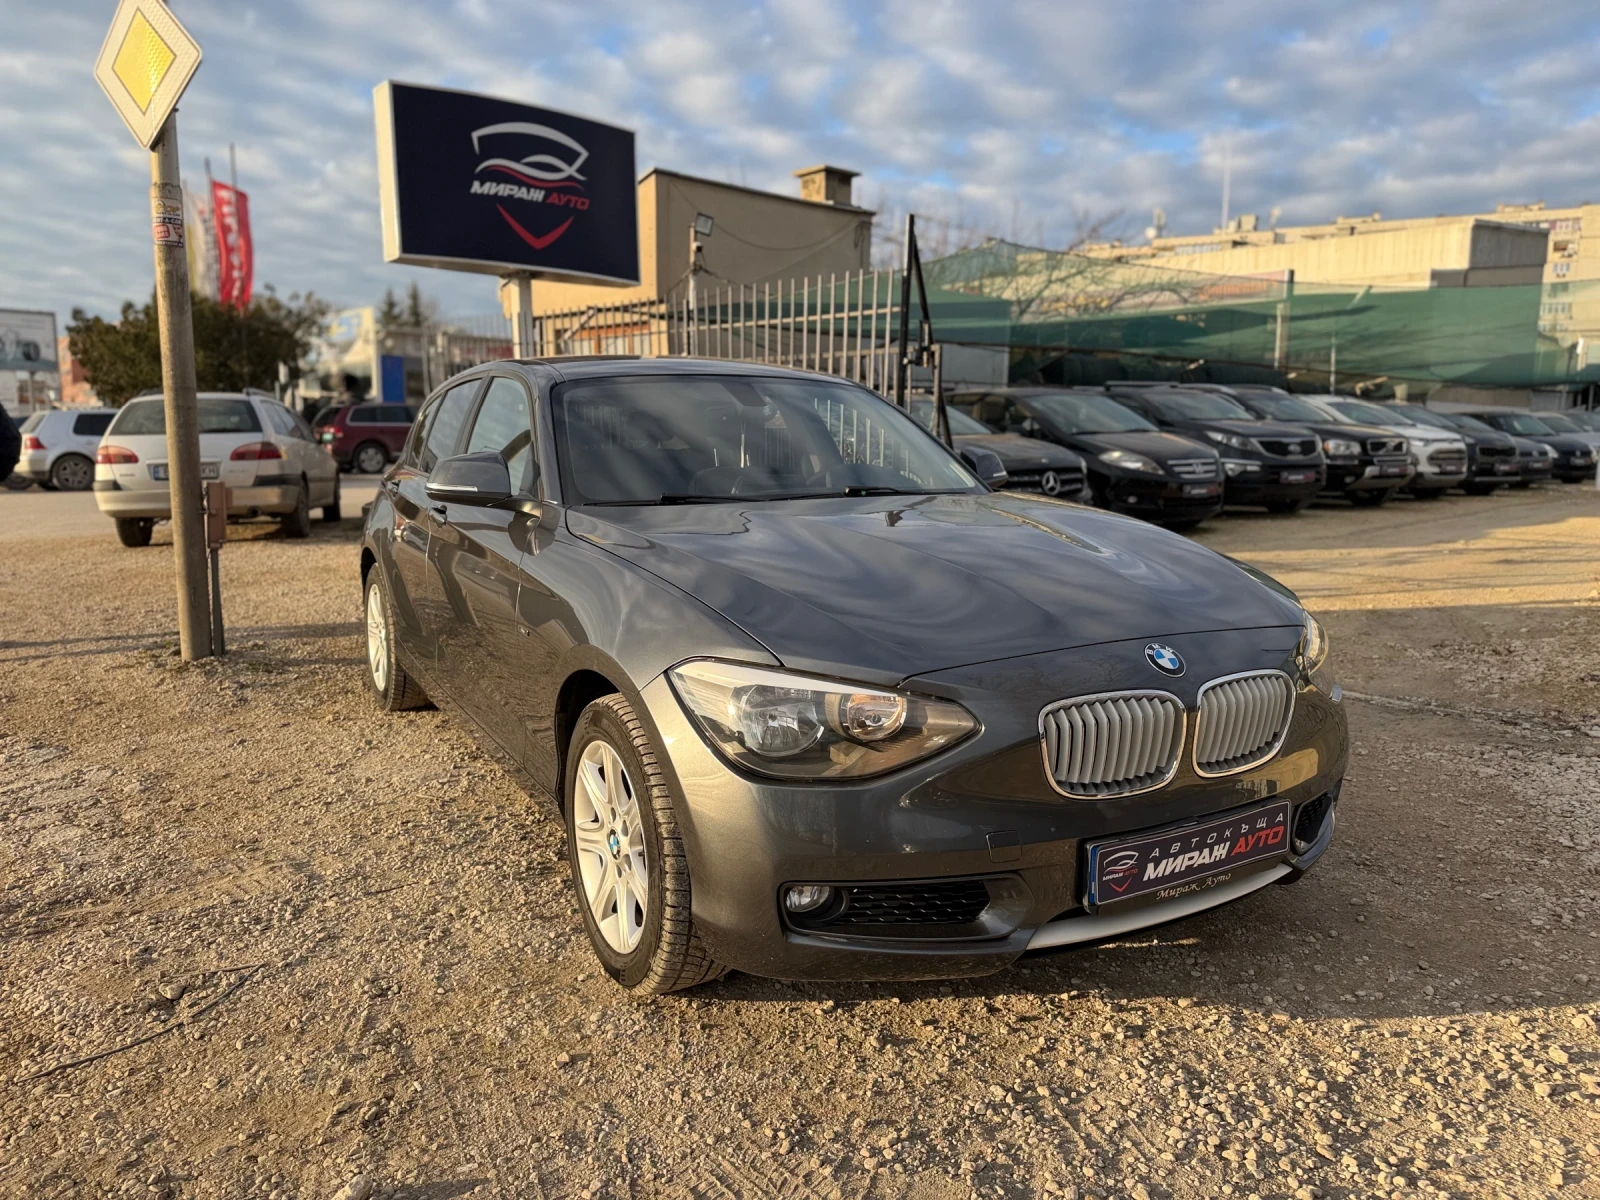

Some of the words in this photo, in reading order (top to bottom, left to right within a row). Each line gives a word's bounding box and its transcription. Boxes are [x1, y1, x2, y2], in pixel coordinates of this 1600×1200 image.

[469, 180, 546, 202] МИРАЖ
[546, 193, 590, 210] АУТО
[1142, 841, 1231, 882] МИРАЖ
[1230, 826, 1285, 857] АУТО
[1148, 812, 1285, 859] АВТОКЪЩА
[1155, 882, 1201, 900] Мираж
[1201, 872, 1232, 889] Ауто
